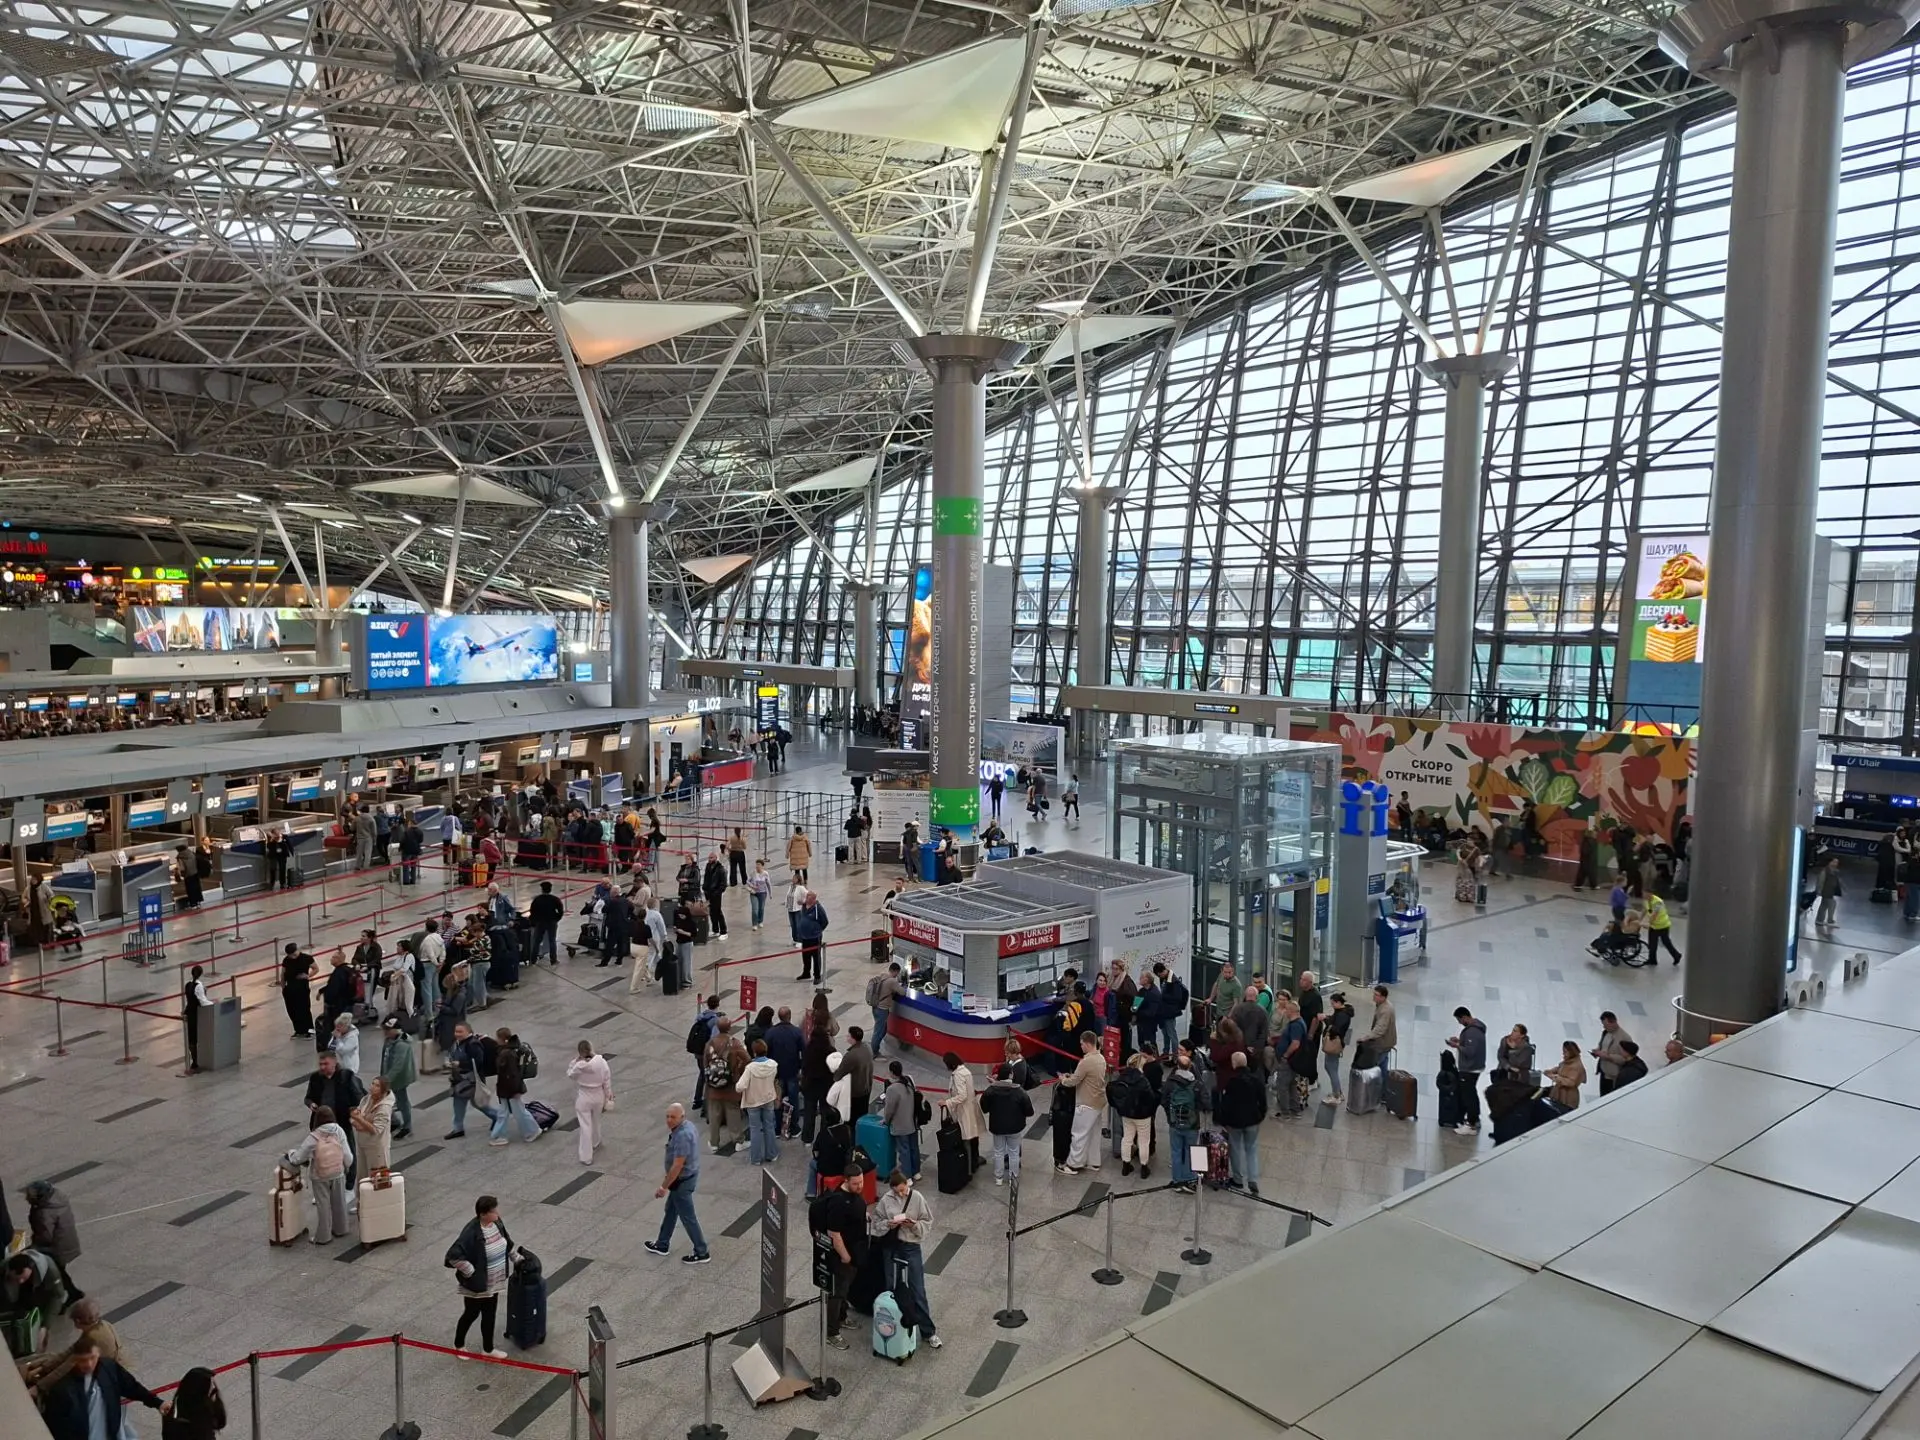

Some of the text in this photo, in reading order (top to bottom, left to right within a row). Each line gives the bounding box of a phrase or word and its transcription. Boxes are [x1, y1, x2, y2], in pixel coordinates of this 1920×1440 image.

[1646, 544, 1687, 555] ШАУРМА
[1638, 605, 1685, 617] ДЕСЕРТЫ
[968, 590, 978, 675] Meeting point
[933, 626, 941, 675] Meeting
[967, 683, 976, 775] Место встречи
[931, 736, 939, 774] Место
[444, 762, 455, 772] 98
[465, 759, 476, 769] 99
[1411, 760, 1453, 772] СКОРО
[1858, 758, 1881, 768] Utair
[351, 776, 364, 787] 97
[1386, 771, 1453, 786] ОТКРЫТИЕ
[324, 780, 337, 791] 96
[172, 802, 188, 814] 94
[206, 797, 221, 809] 95
[19, 823, 38, 837] 93
[909, 919, 936, 934] TURKISH
[1022, 926, 1054, 939] TURKISH
[909, 928, 936, 942] AIRLINES
[1022, 934, 1054, 948] AIRLINES
